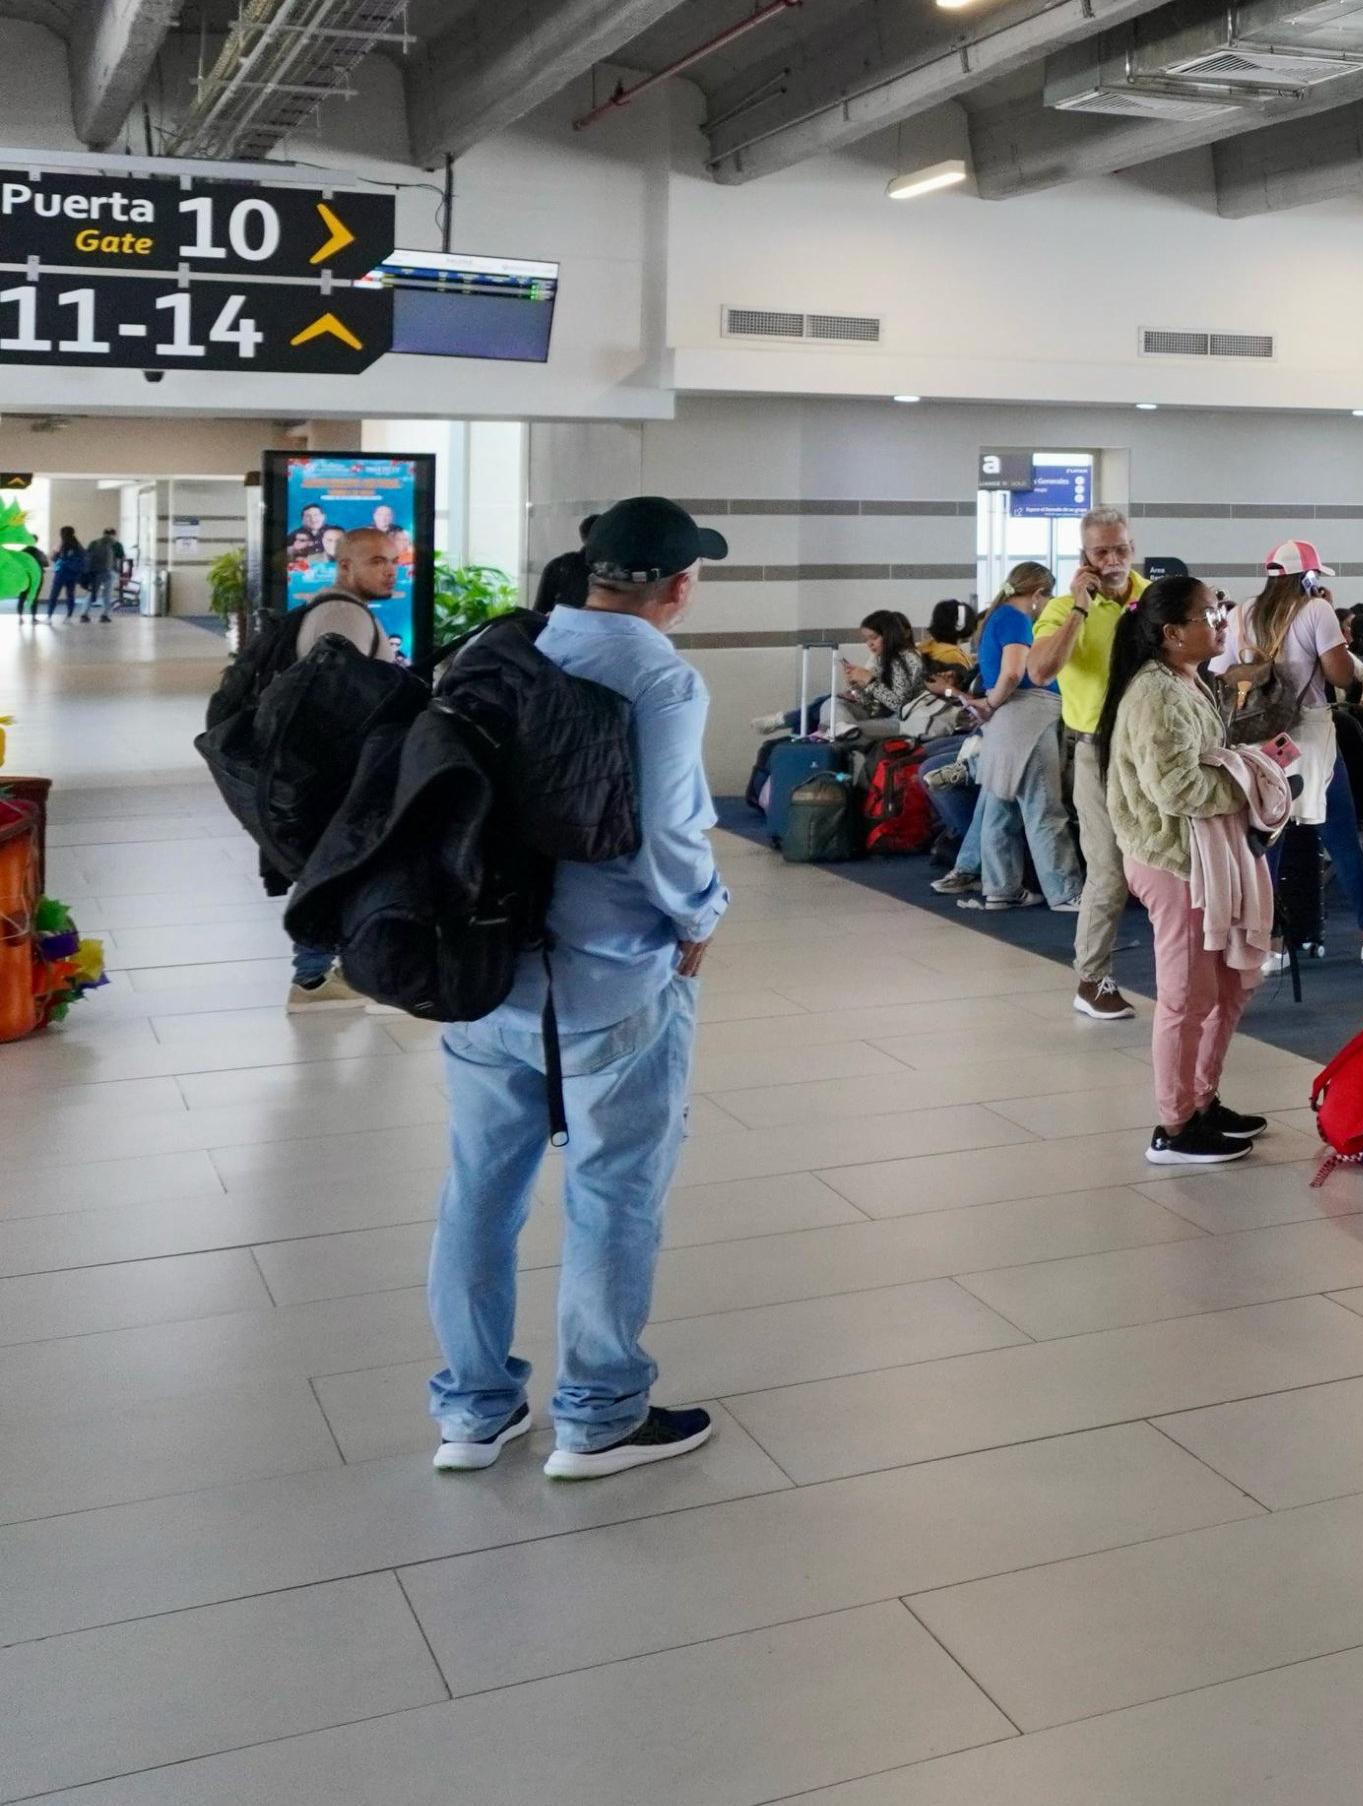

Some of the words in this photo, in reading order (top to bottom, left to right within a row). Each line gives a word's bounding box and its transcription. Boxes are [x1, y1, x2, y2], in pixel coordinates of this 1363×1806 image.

[2, 183, 155, 222] Puerta
[178, 197, 281, 261] 10
[75, 229, 154, 255] Gate
[0, 286, 264, 358] 11-14
